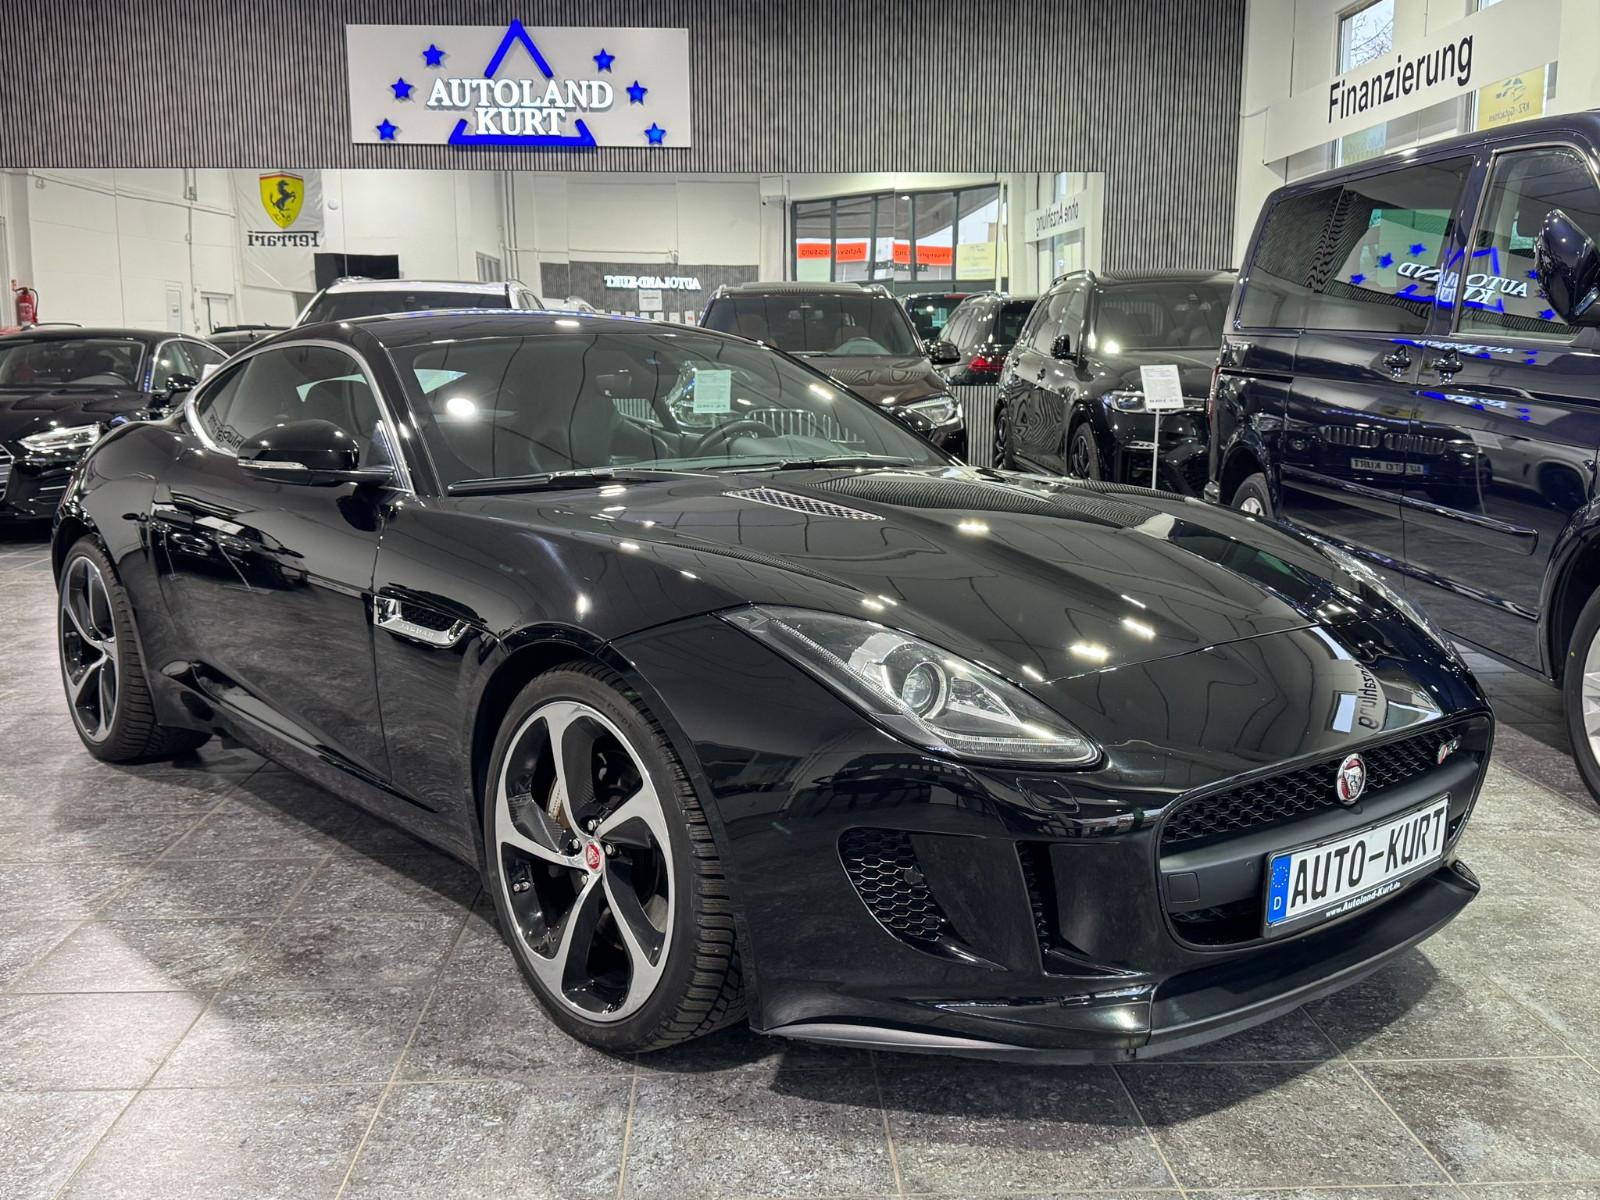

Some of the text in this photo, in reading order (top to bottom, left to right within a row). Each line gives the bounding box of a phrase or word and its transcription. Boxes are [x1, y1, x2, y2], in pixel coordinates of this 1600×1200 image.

[427, 78, 614, 109] AUTOLAND
[1328, 34, 1474, 124] Finanzierung
[474, 107, 566, 136] KURT
[1273, 806, 1445, 911] D AUTO-KURT
[1325, 882, 1401, 918] www.Autoland-Kurt.de
